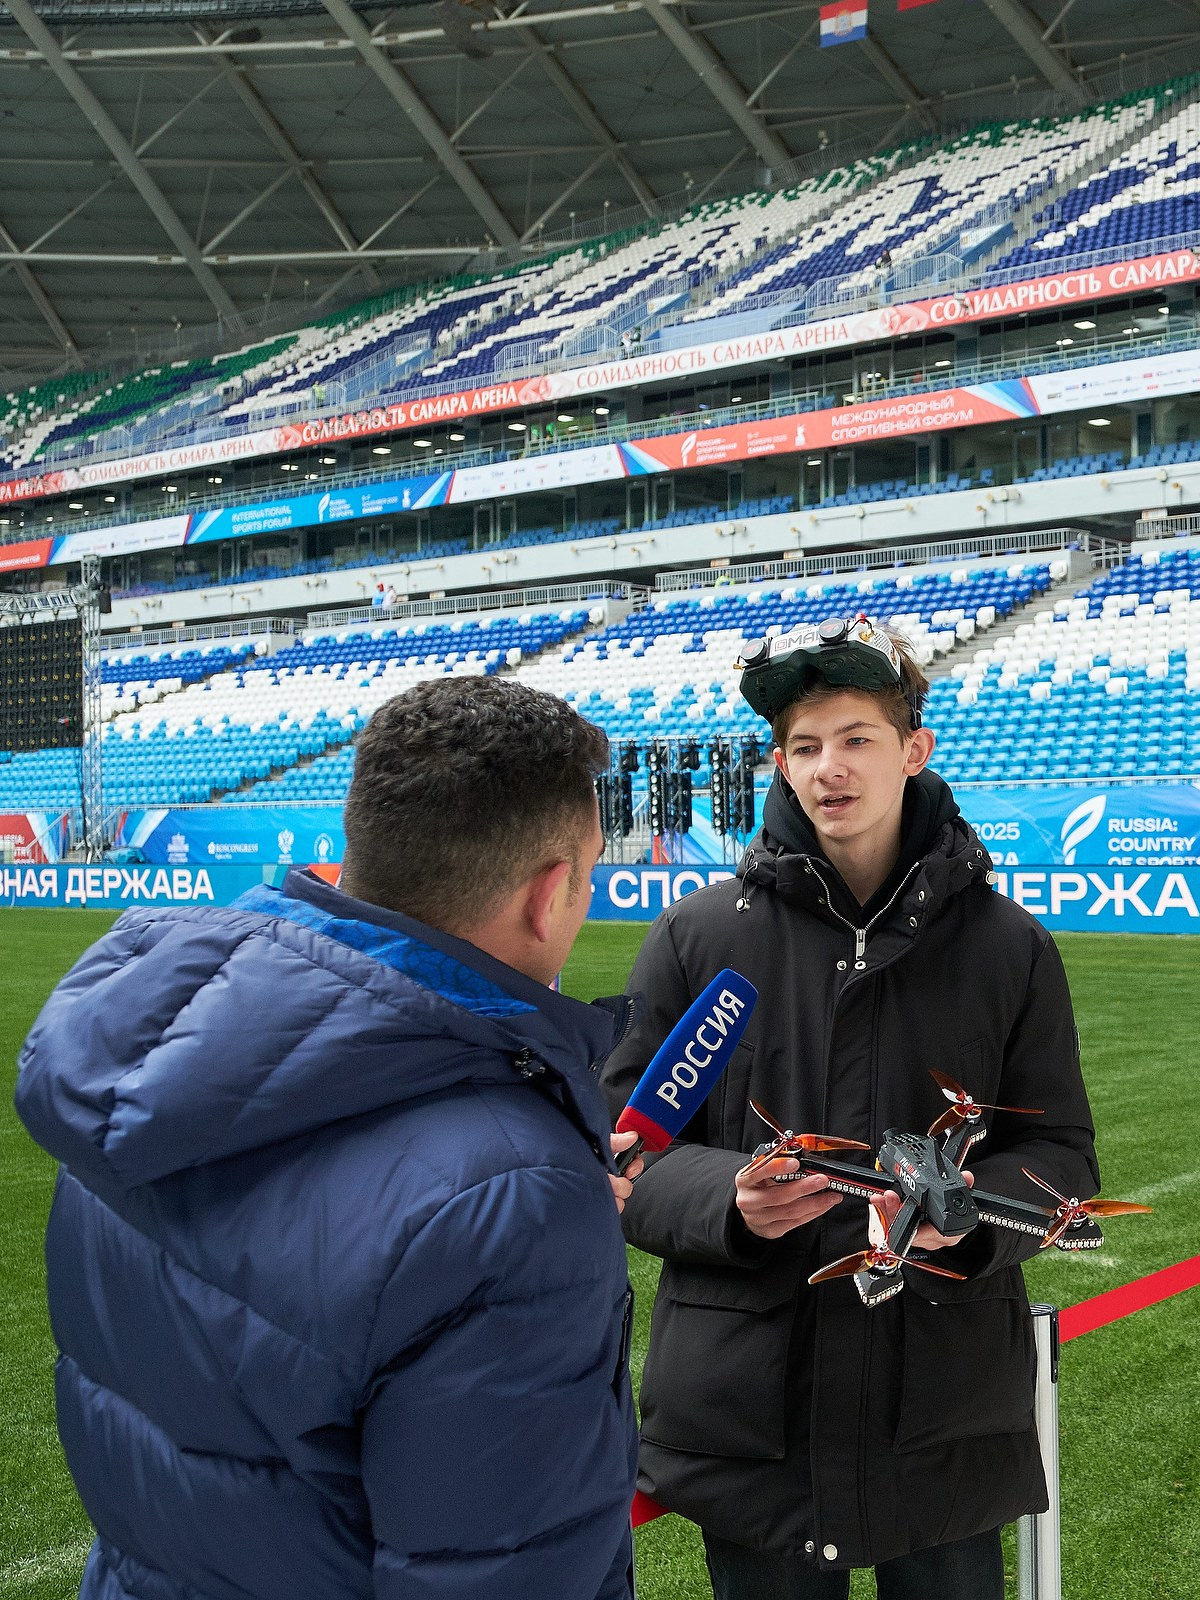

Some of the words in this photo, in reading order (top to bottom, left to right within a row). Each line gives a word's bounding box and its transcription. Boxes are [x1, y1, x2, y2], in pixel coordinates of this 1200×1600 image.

[930, 272, 1102, 322] СОЛИДАРНОСТЬ
[576, 351, 707, 390] СОЛИДАРНОСТЬ
[713, 335, 786, 361] САМАРА
[791, 323, 850, 350] АРЕНА
[409, 397, 468, 422] САМАРА
[472, 386, 518, 410] АРЕНА
[831, 395, 955, 427] МЕЖДУНАРОДНЫЙ
[831, 416, 921, 442] СПОРТИВНЫЙ
[922, 409, 974, 428] ФОРУМ
[82, 458, 166, 483] СОЛИДАРНОСТЬ
[169, 448, 216, 466] САМАРА
[219, 439, 255, 457] АРЕНА
[232, 505, 292, 523] INTERNATIONAL
[788, 631, 819, 648] MA
[1107, 817, 1178, 833] RUSSIA:
[1107, 837, 1196, 851] COUNTRY
[0, 868, 58, 898] НАЯ
[65, 868, 214, 904] ДЕРЖАВА
[656, 988, 746, 1110] РОССИЯ
